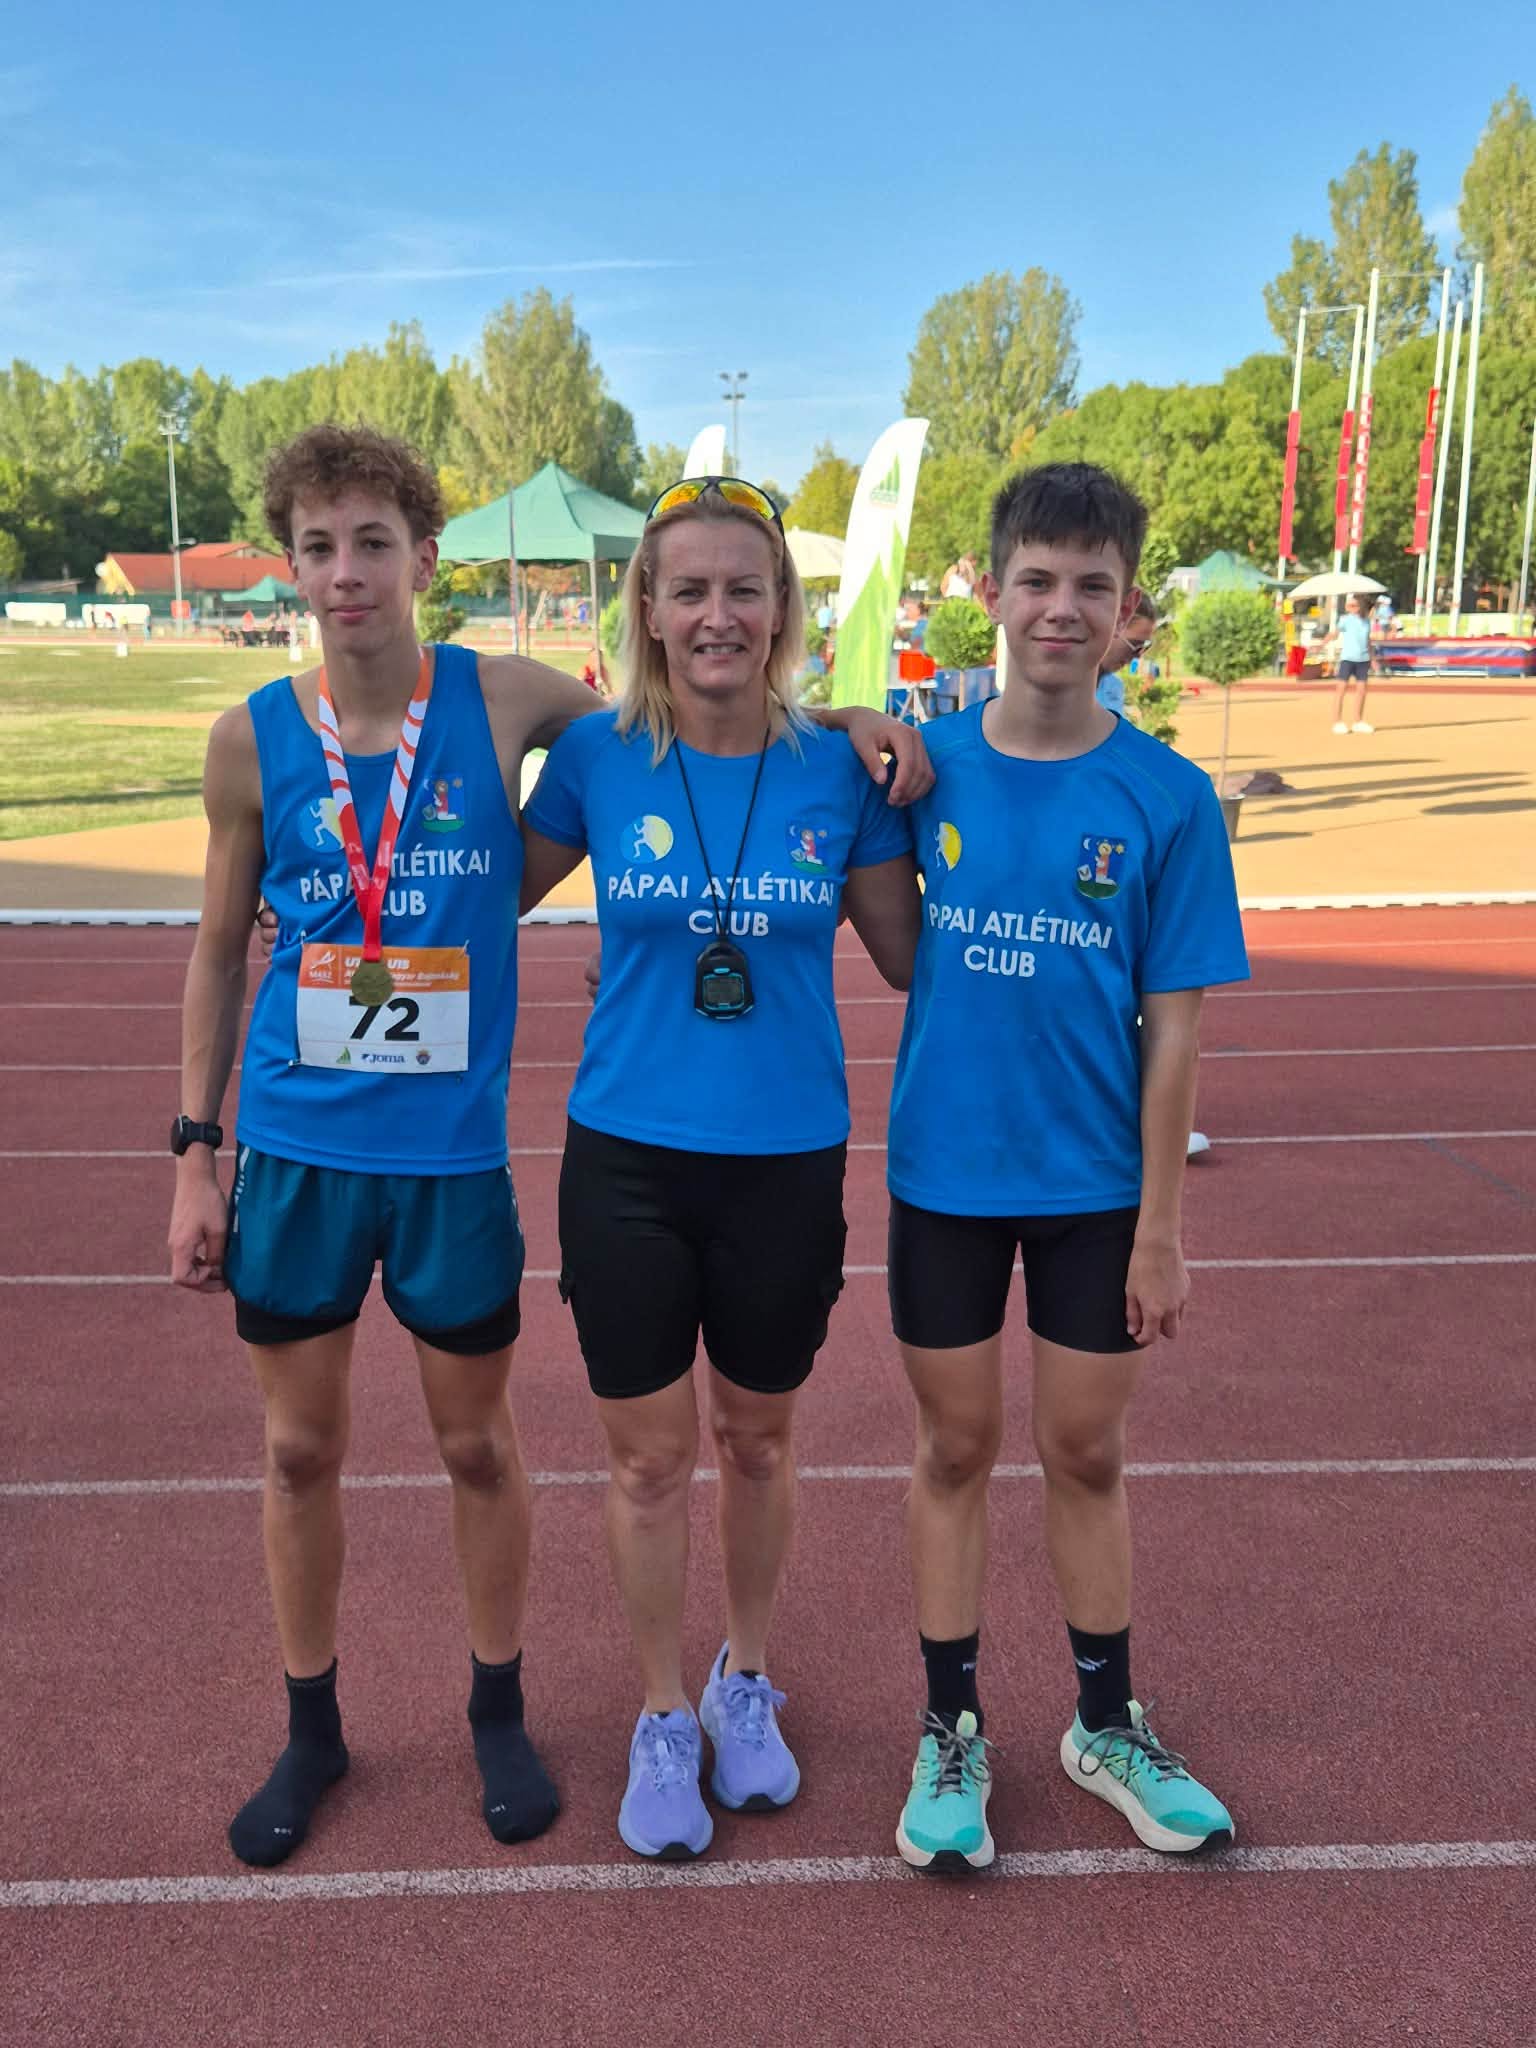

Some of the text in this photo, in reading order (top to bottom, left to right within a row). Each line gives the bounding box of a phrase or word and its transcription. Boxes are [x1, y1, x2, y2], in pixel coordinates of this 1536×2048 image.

[300, 868, 355, 902] PÁP
[391, 843, 490, 878] TLÉTIKAI
[608, 868, 834, 907] PÁPAI ATLÉTIKAI
[688, 910, 769, 937] CLUB
[928, 902, 1113, 949] PPAI ATLÉTIKAI
[964, 944, 1036, 978] CLUB
[349, 996, 420, 1041] 72
